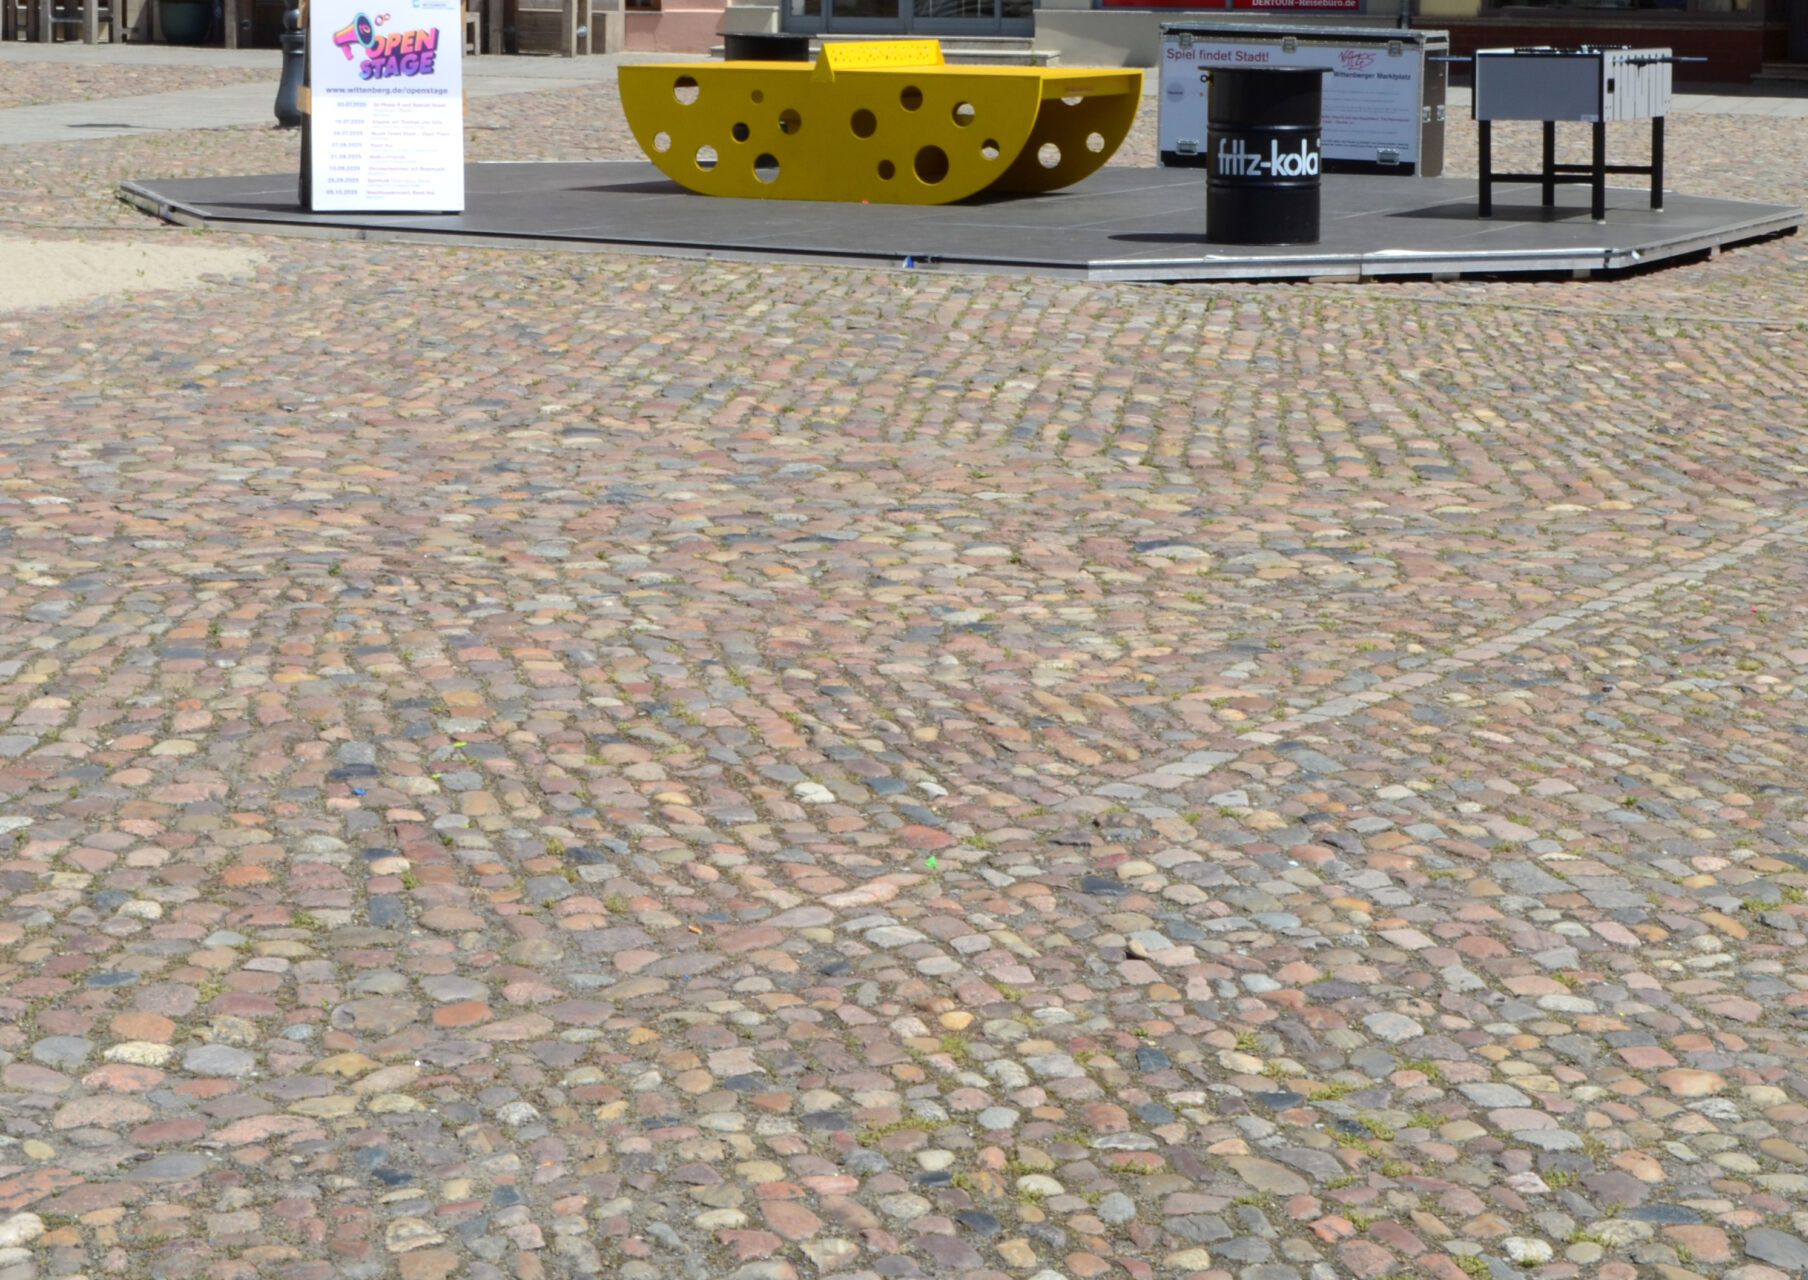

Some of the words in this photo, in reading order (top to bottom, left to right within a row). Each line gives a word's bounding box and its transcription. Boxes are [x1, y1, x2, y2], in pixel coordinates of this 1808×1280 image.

[365, 26, 440, 59] OPEN
[359, 49, 436, 81] STAGE
[1167, 47, 1196, 61] Spiel
[1199, 49, 1232, 61] findet
[1235, 50, 1270, 63] Stadt!
[1376, 72, 1412, 81] Marktplatz
[325, 86, 449, 96] www.wittenberg.de/openstage
[1217, 137, 1320, 177] fritz-kola
